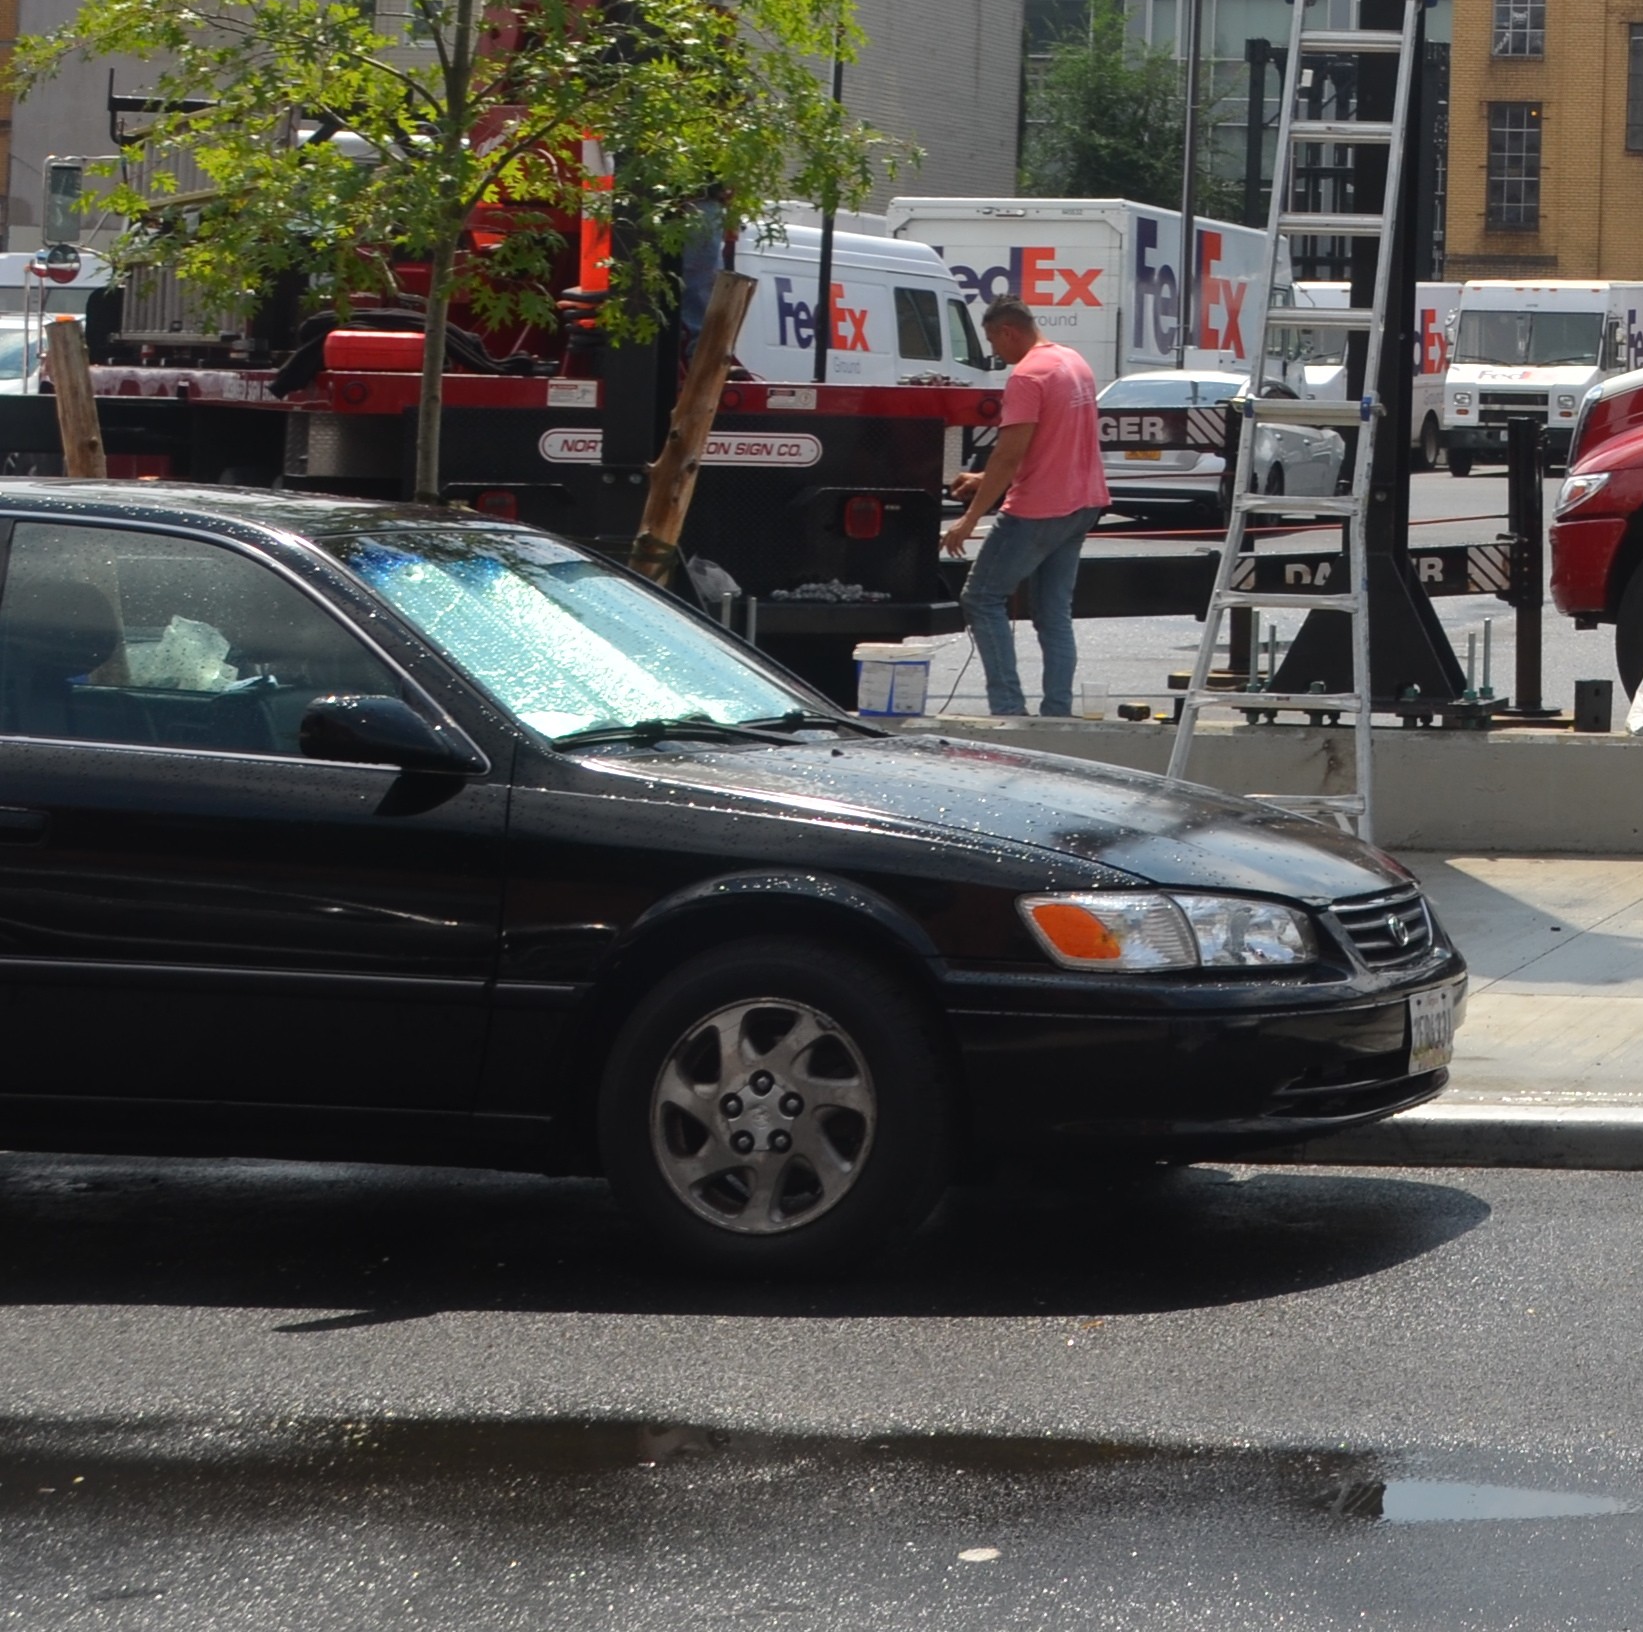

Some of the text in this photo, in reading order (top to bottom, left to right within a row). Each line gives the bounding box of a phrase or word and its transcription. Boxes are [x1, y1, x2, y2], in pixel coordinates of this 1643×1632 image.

[933, 246, 1104, 306] edEx
[1033, 313, 1078, 327] round
[1413, 308, 1451, 377] dEx
[734, 442, 771, 456] SIGN
[776, 444, 804, 456] CO.
